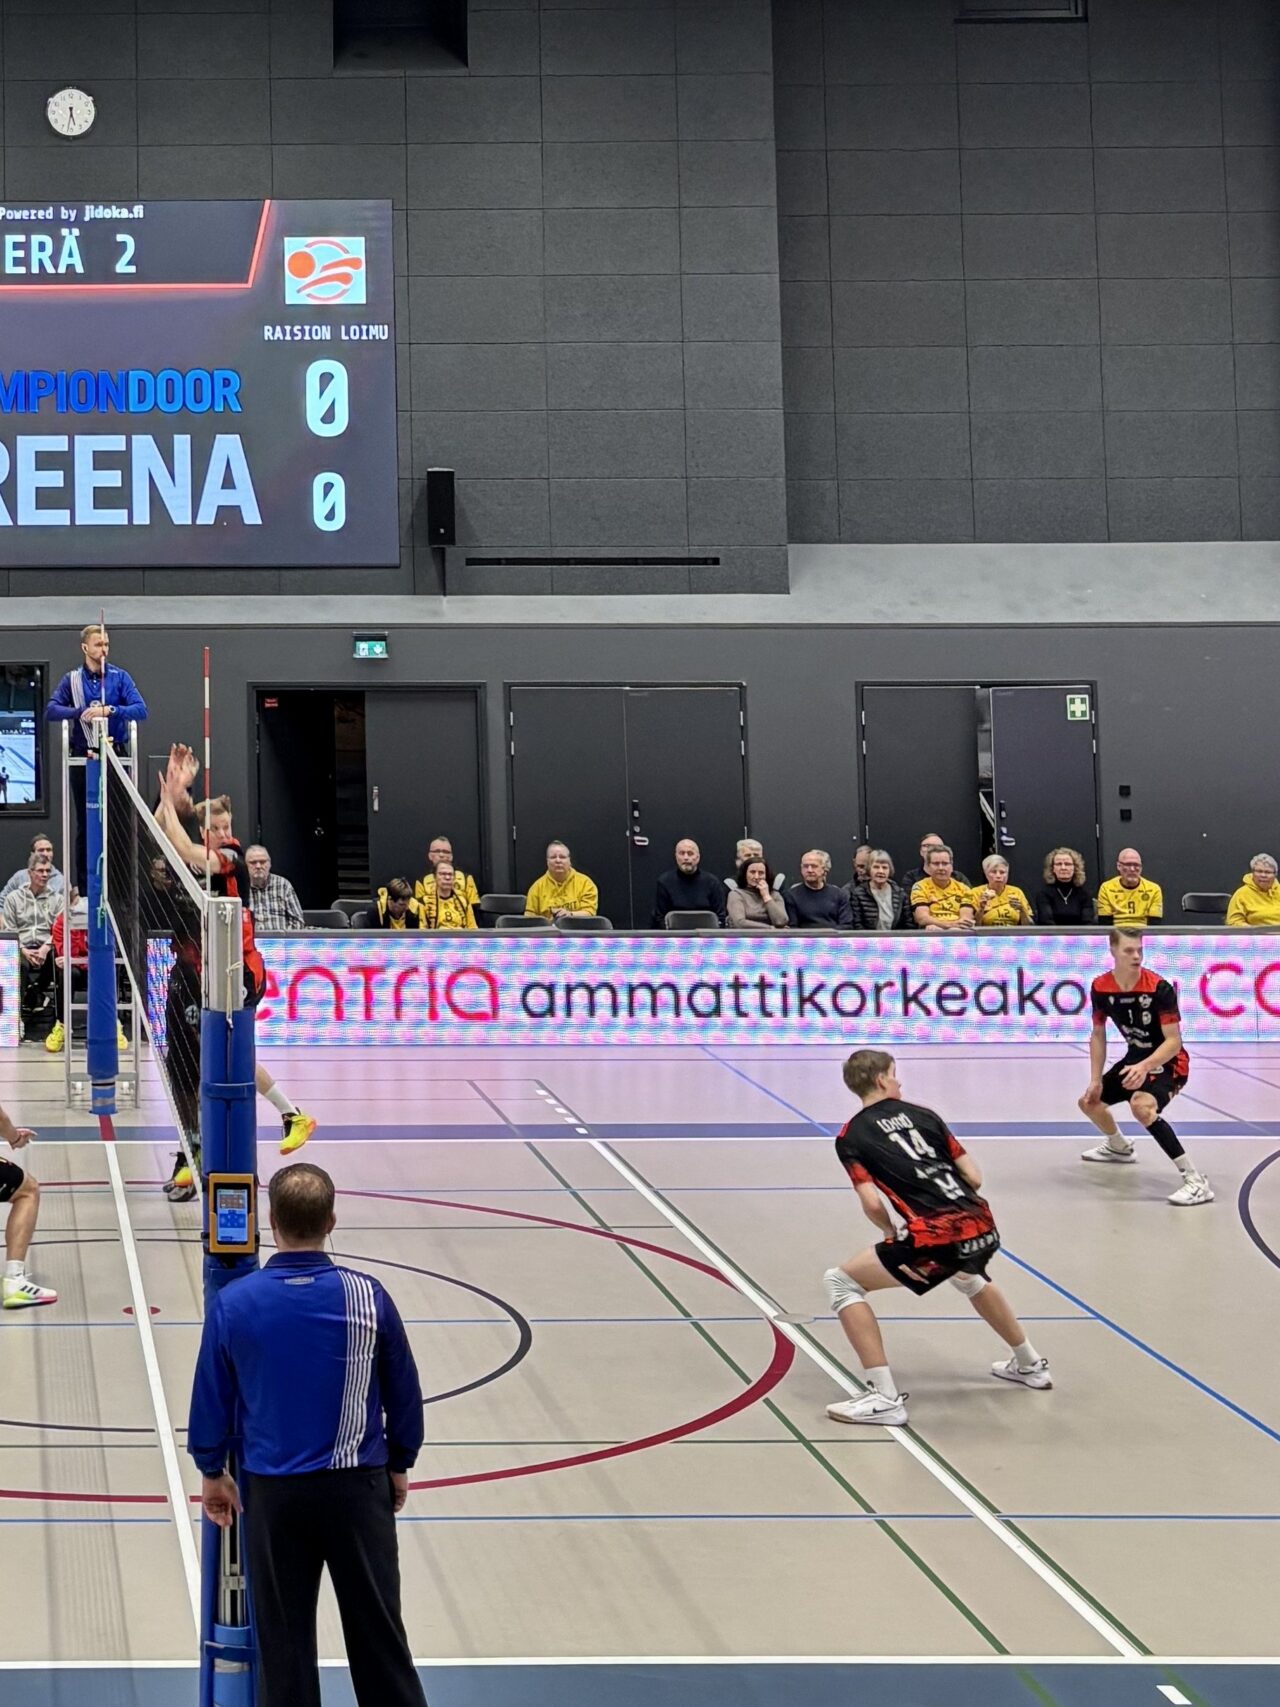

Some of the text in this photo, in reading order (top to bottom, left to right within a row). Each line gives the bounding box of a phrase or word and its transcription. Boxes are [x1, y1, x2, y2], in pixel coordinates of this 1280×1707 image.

[61, 206, 77, 221] by
[84, 205, 144, 221] jidoka.fi
[4, 228, 137, 274] ERÄ 2
[264, 325, 389, 340] RAISION LOIMU
[306, 359, 349, 437] 0
[313, 471, 345, 532] 0
[521, 967, 1180, 1018] ammattikorkeako
[888, 1128, 937, 1161] 14
